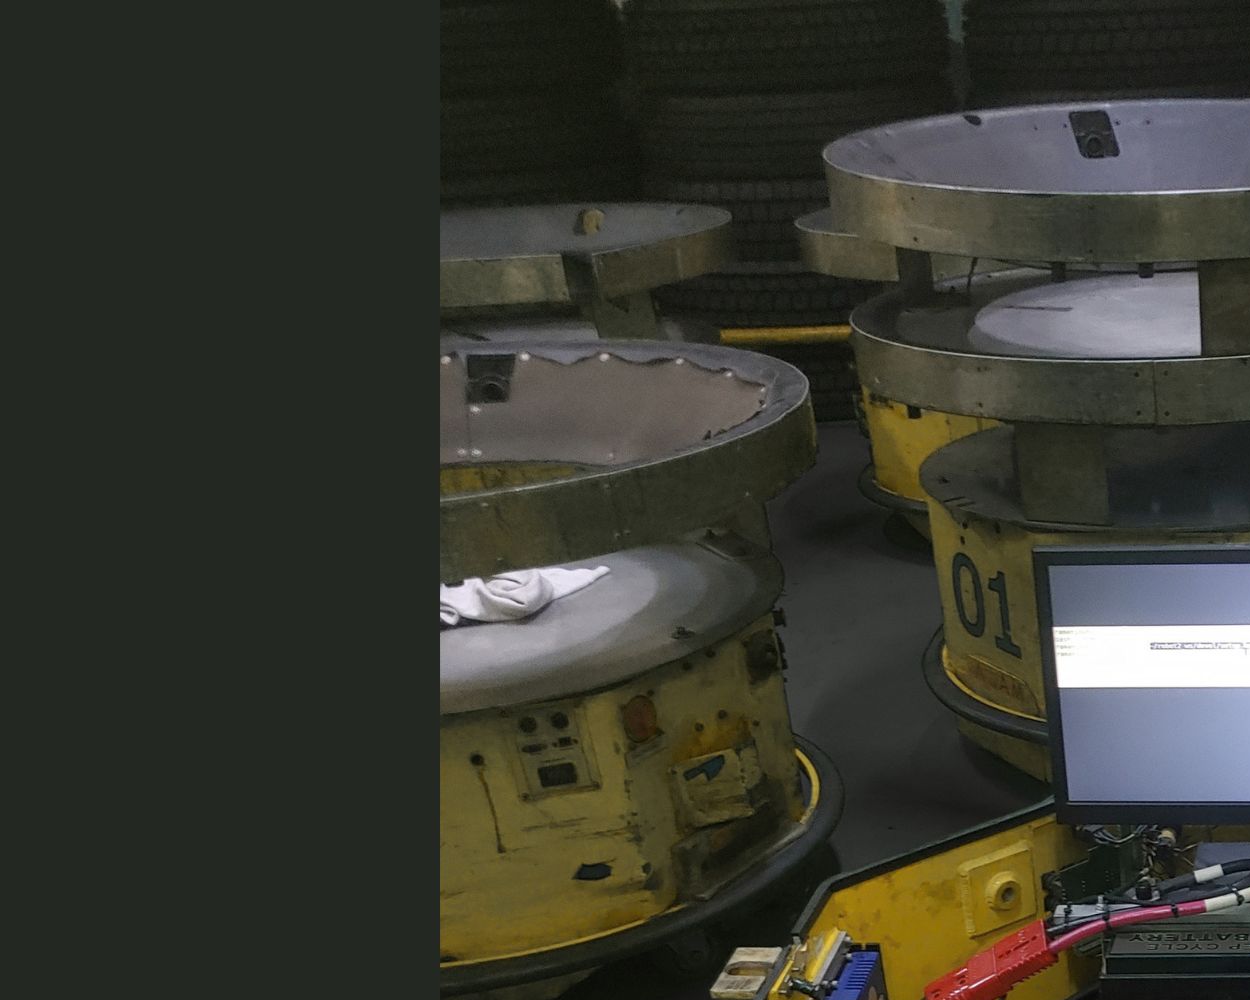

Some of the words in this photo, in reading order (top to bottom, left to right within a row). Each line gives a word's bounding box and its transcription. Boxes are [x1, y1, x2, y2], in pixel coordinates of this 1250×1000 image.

[952, 552, 1022, 660] 01
[1128, 932, 1249, 942] BATTERY
[1145, 942, 1219, 950] CYCLE
